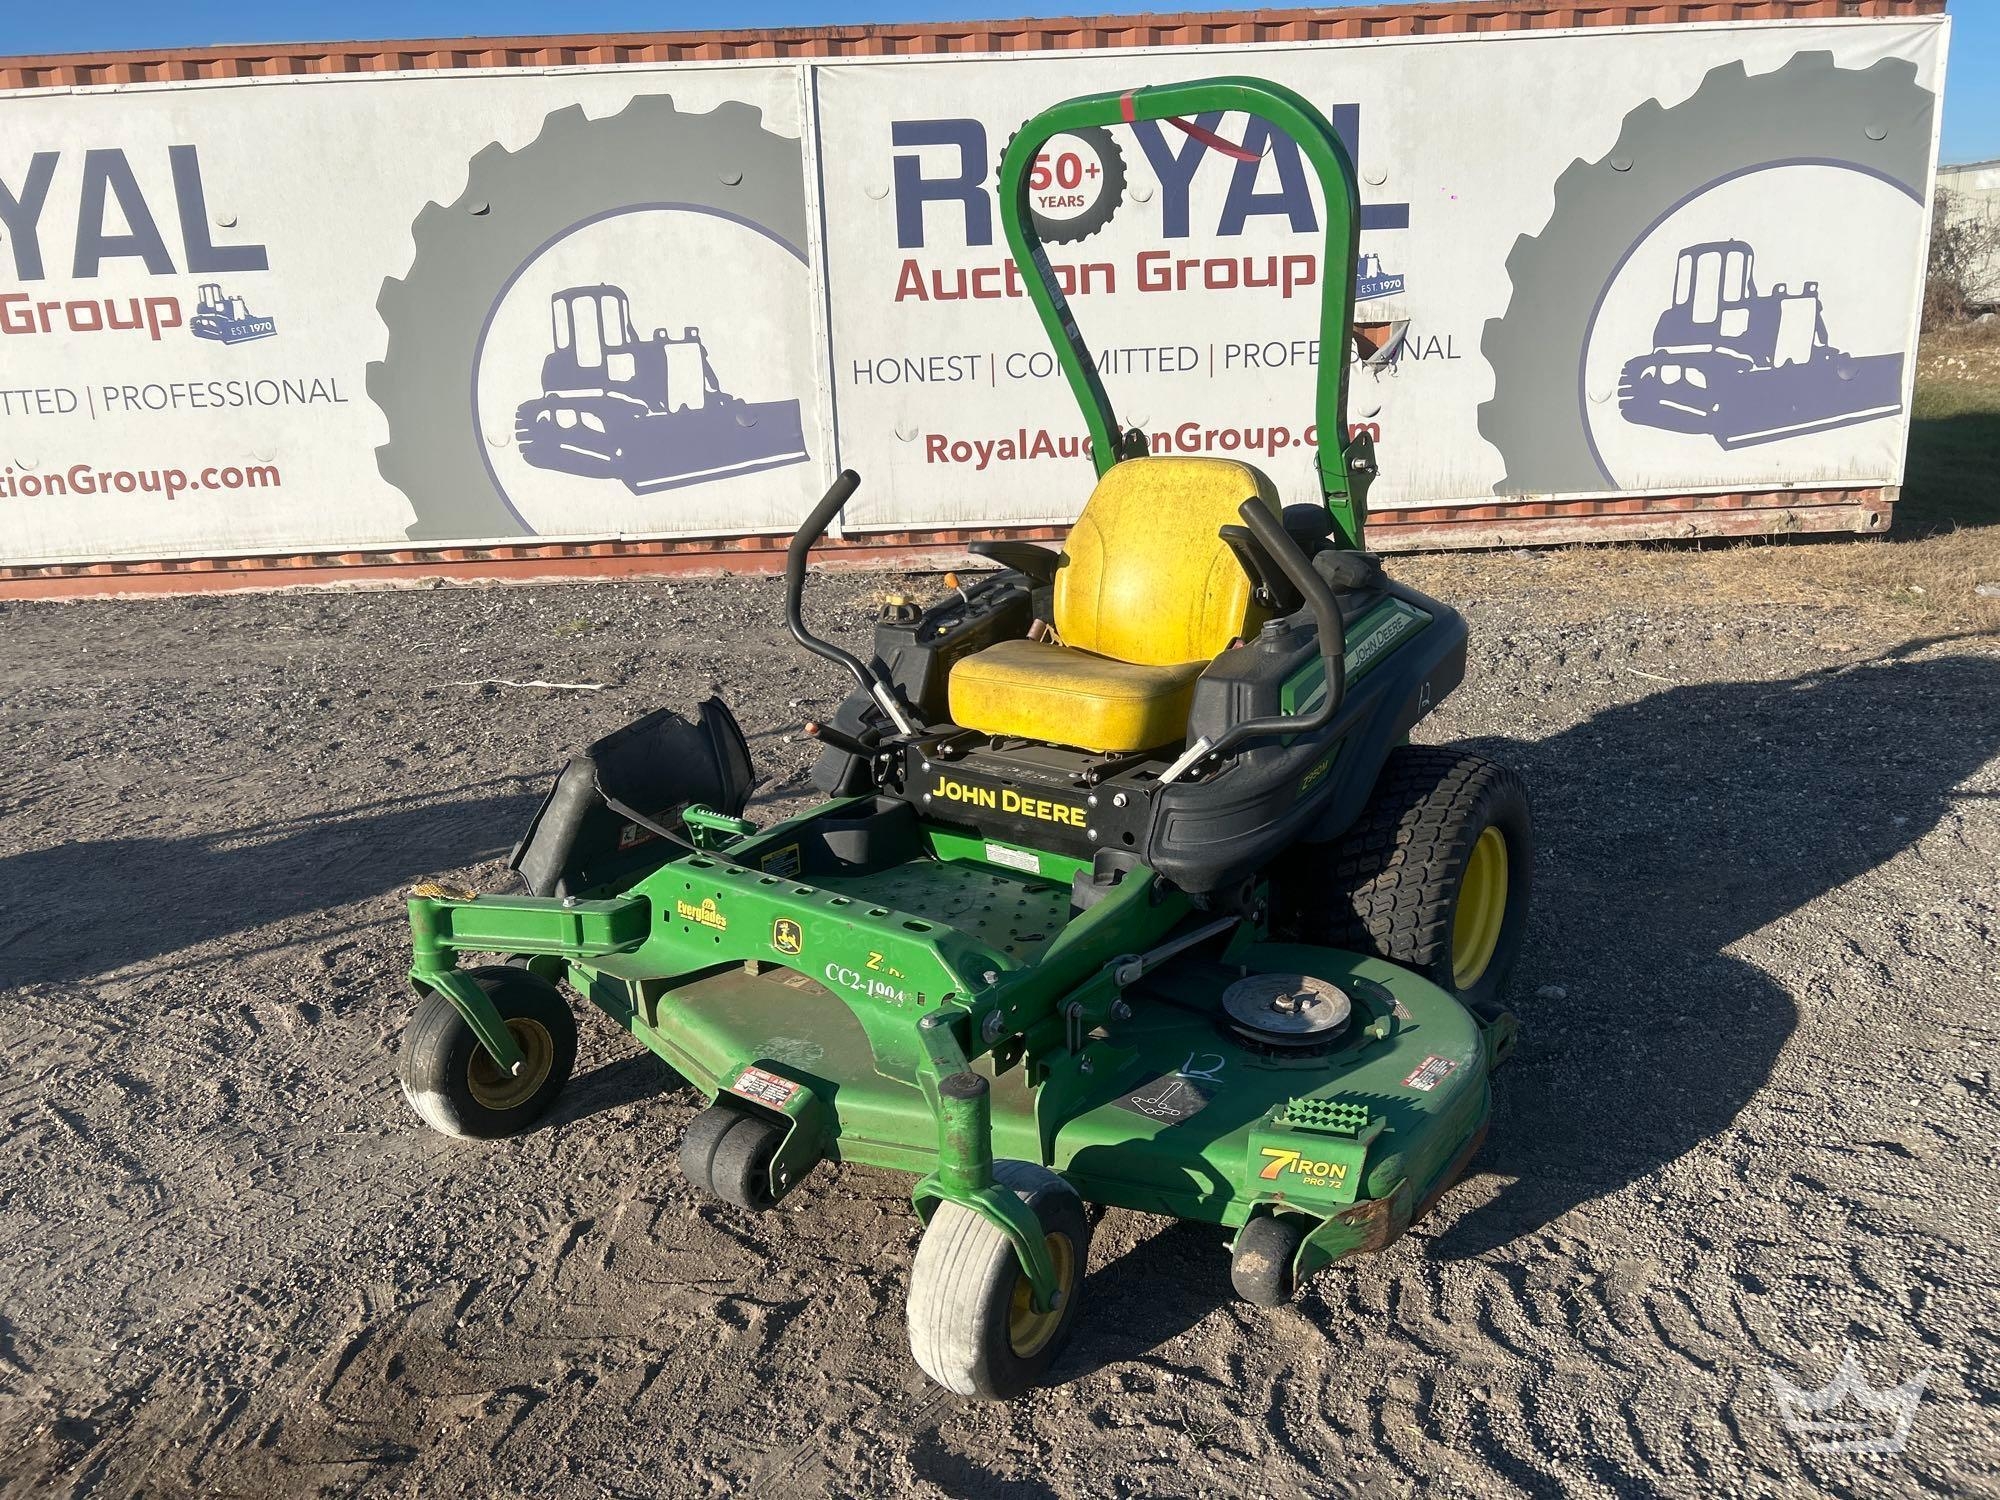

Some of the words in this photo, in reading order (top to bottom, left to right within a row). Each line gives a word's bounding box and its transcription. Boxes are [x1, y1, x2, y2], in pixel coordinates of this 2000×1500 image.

[1030, 152, 1100, 191] 50+
[1038, 195, 1085, 208] YEARS
[894, 258, 1115, 302] Aucton
[1137, 250, 1315, 298] Group
[1361, 283, 1377, 293] EST.
[1379, 279, 1401, 291] 1970
[0, 292, 182, 341] Group
[230, 326, 248, 336] EST.
[249, 321, 272, 333] 1970
[853, 354, 981, 384] HONEST
[1006, 346, 1199, 378] COITTED
[1225, 334, 1461, 369] PROFENAL
[103, 378, 348, 411] PROFESSIONAL
[1354, 638, 1378, 666] JOHN
[1376, 617, 1404, 648] DEERE
[932, 776, 996, 809] JOHN
[1002, 789, 1087, 828] DEERE
[677, 900, 727, 927] Everglades
[1303, 1177, 1325, 1187] PRO
[1328, 1180, 1342, 1189] 72
